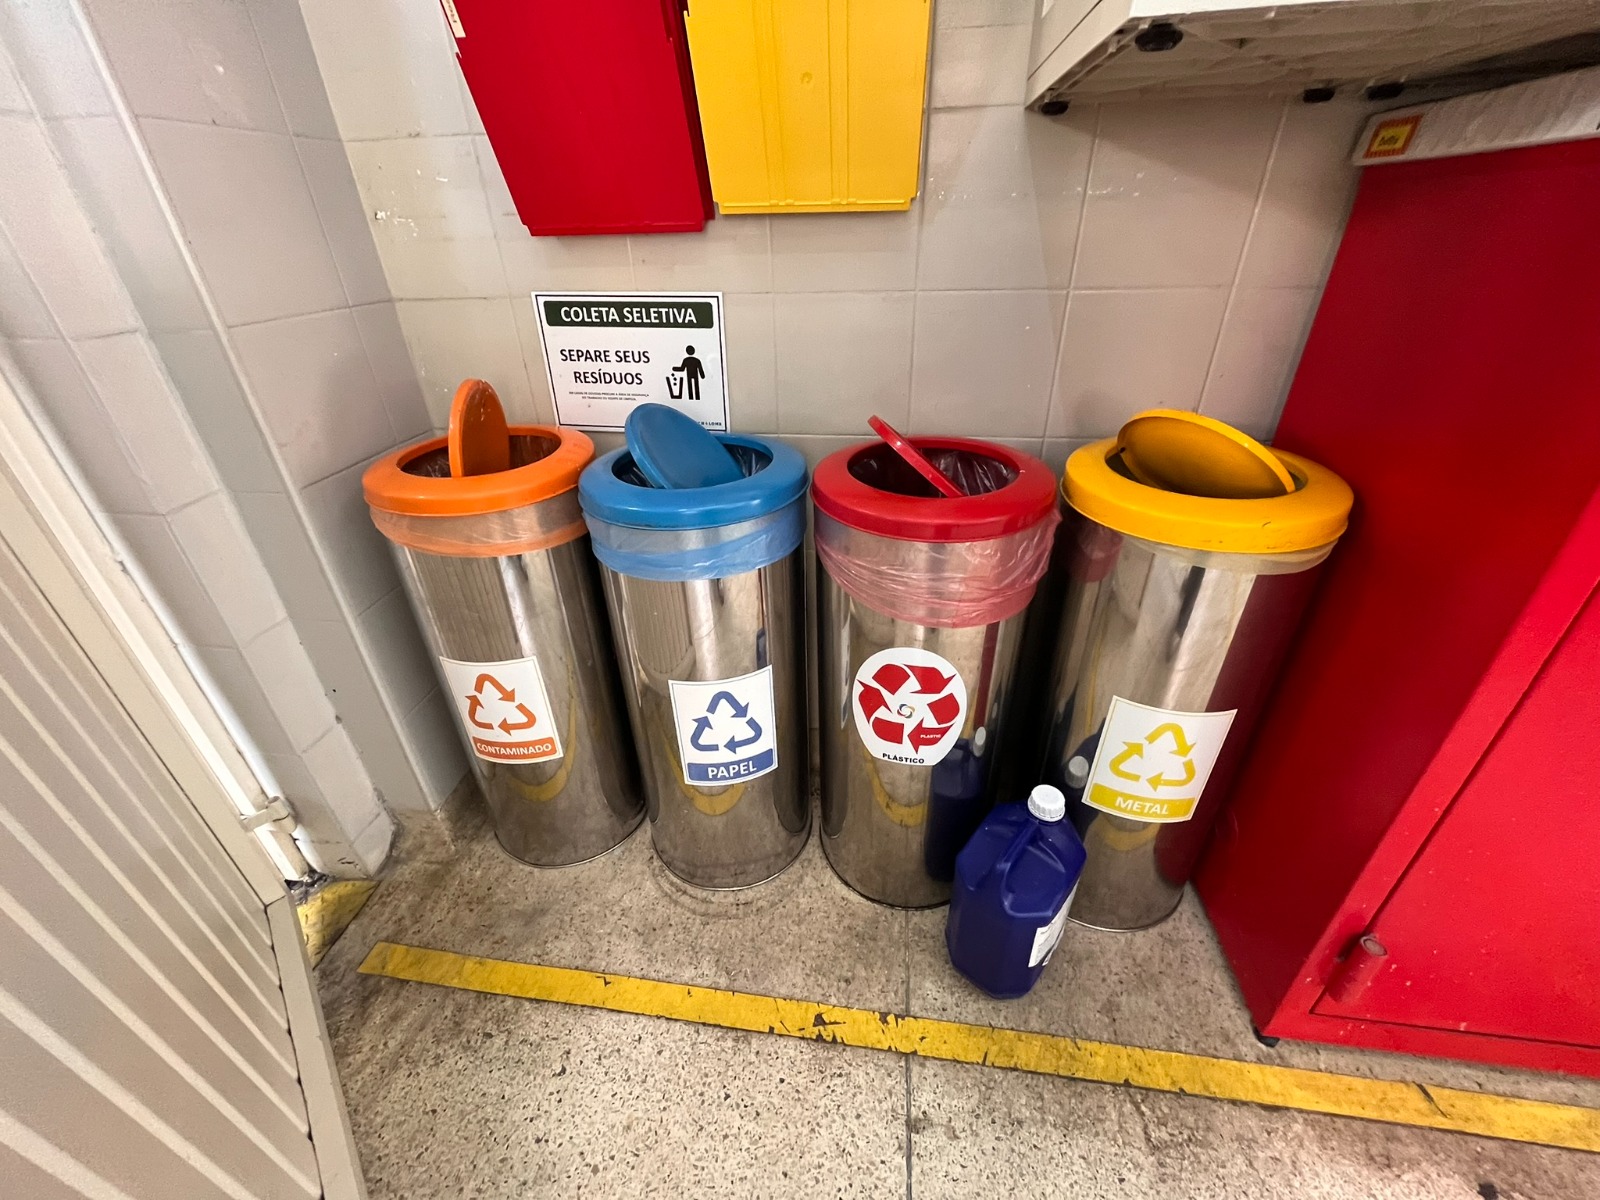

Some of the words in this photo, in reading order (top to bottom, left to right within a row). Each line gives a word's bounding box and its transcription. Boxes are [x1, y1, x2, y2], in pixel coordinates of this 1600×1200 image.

[560, 306, 620, 323] COLETA
[622, 307, 698, 324] SELETIVA
[560, 348, 612, 363] SEPARE
[615, 350, 651, 364] SEUS
[573, 368, 643, 385] RESÍDUOS
[476, 741, 553, 756] CONTAMINADO
[882, 752, 925, 764] PLÁSTICO
[708, 761, 758, 780] PAPEL
[1114, 795, 1171, 815] METAL
